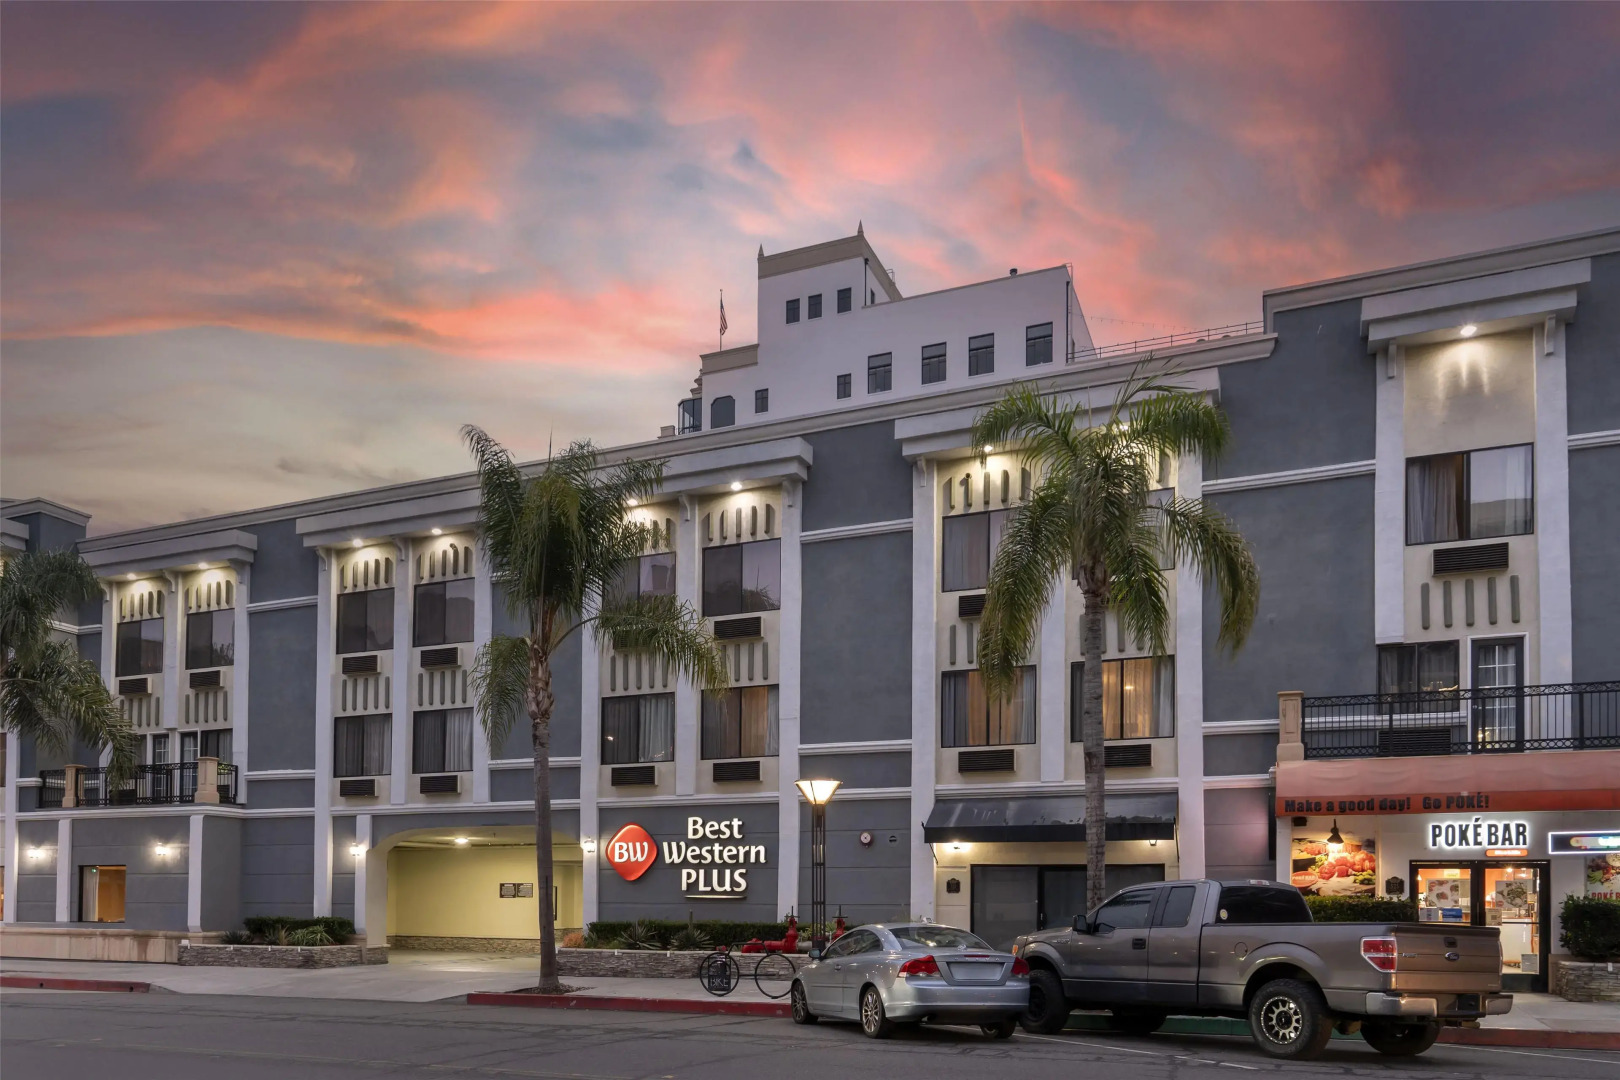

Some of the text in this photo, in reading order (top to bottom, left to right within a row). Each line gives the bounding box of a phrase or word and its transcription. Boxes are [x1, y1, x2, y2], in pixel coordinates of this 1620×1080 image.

[1284, 792, 1490, 813] Make a good day! Go POKÉ!
[687, 816, 743, 840] Best
[1431, 817, 1527, 847] POKÉ BAR
[614, 841, 649, 863] BW
[662, 841, 767, 864] Western
[681, 868, 747, 892] PLUS
